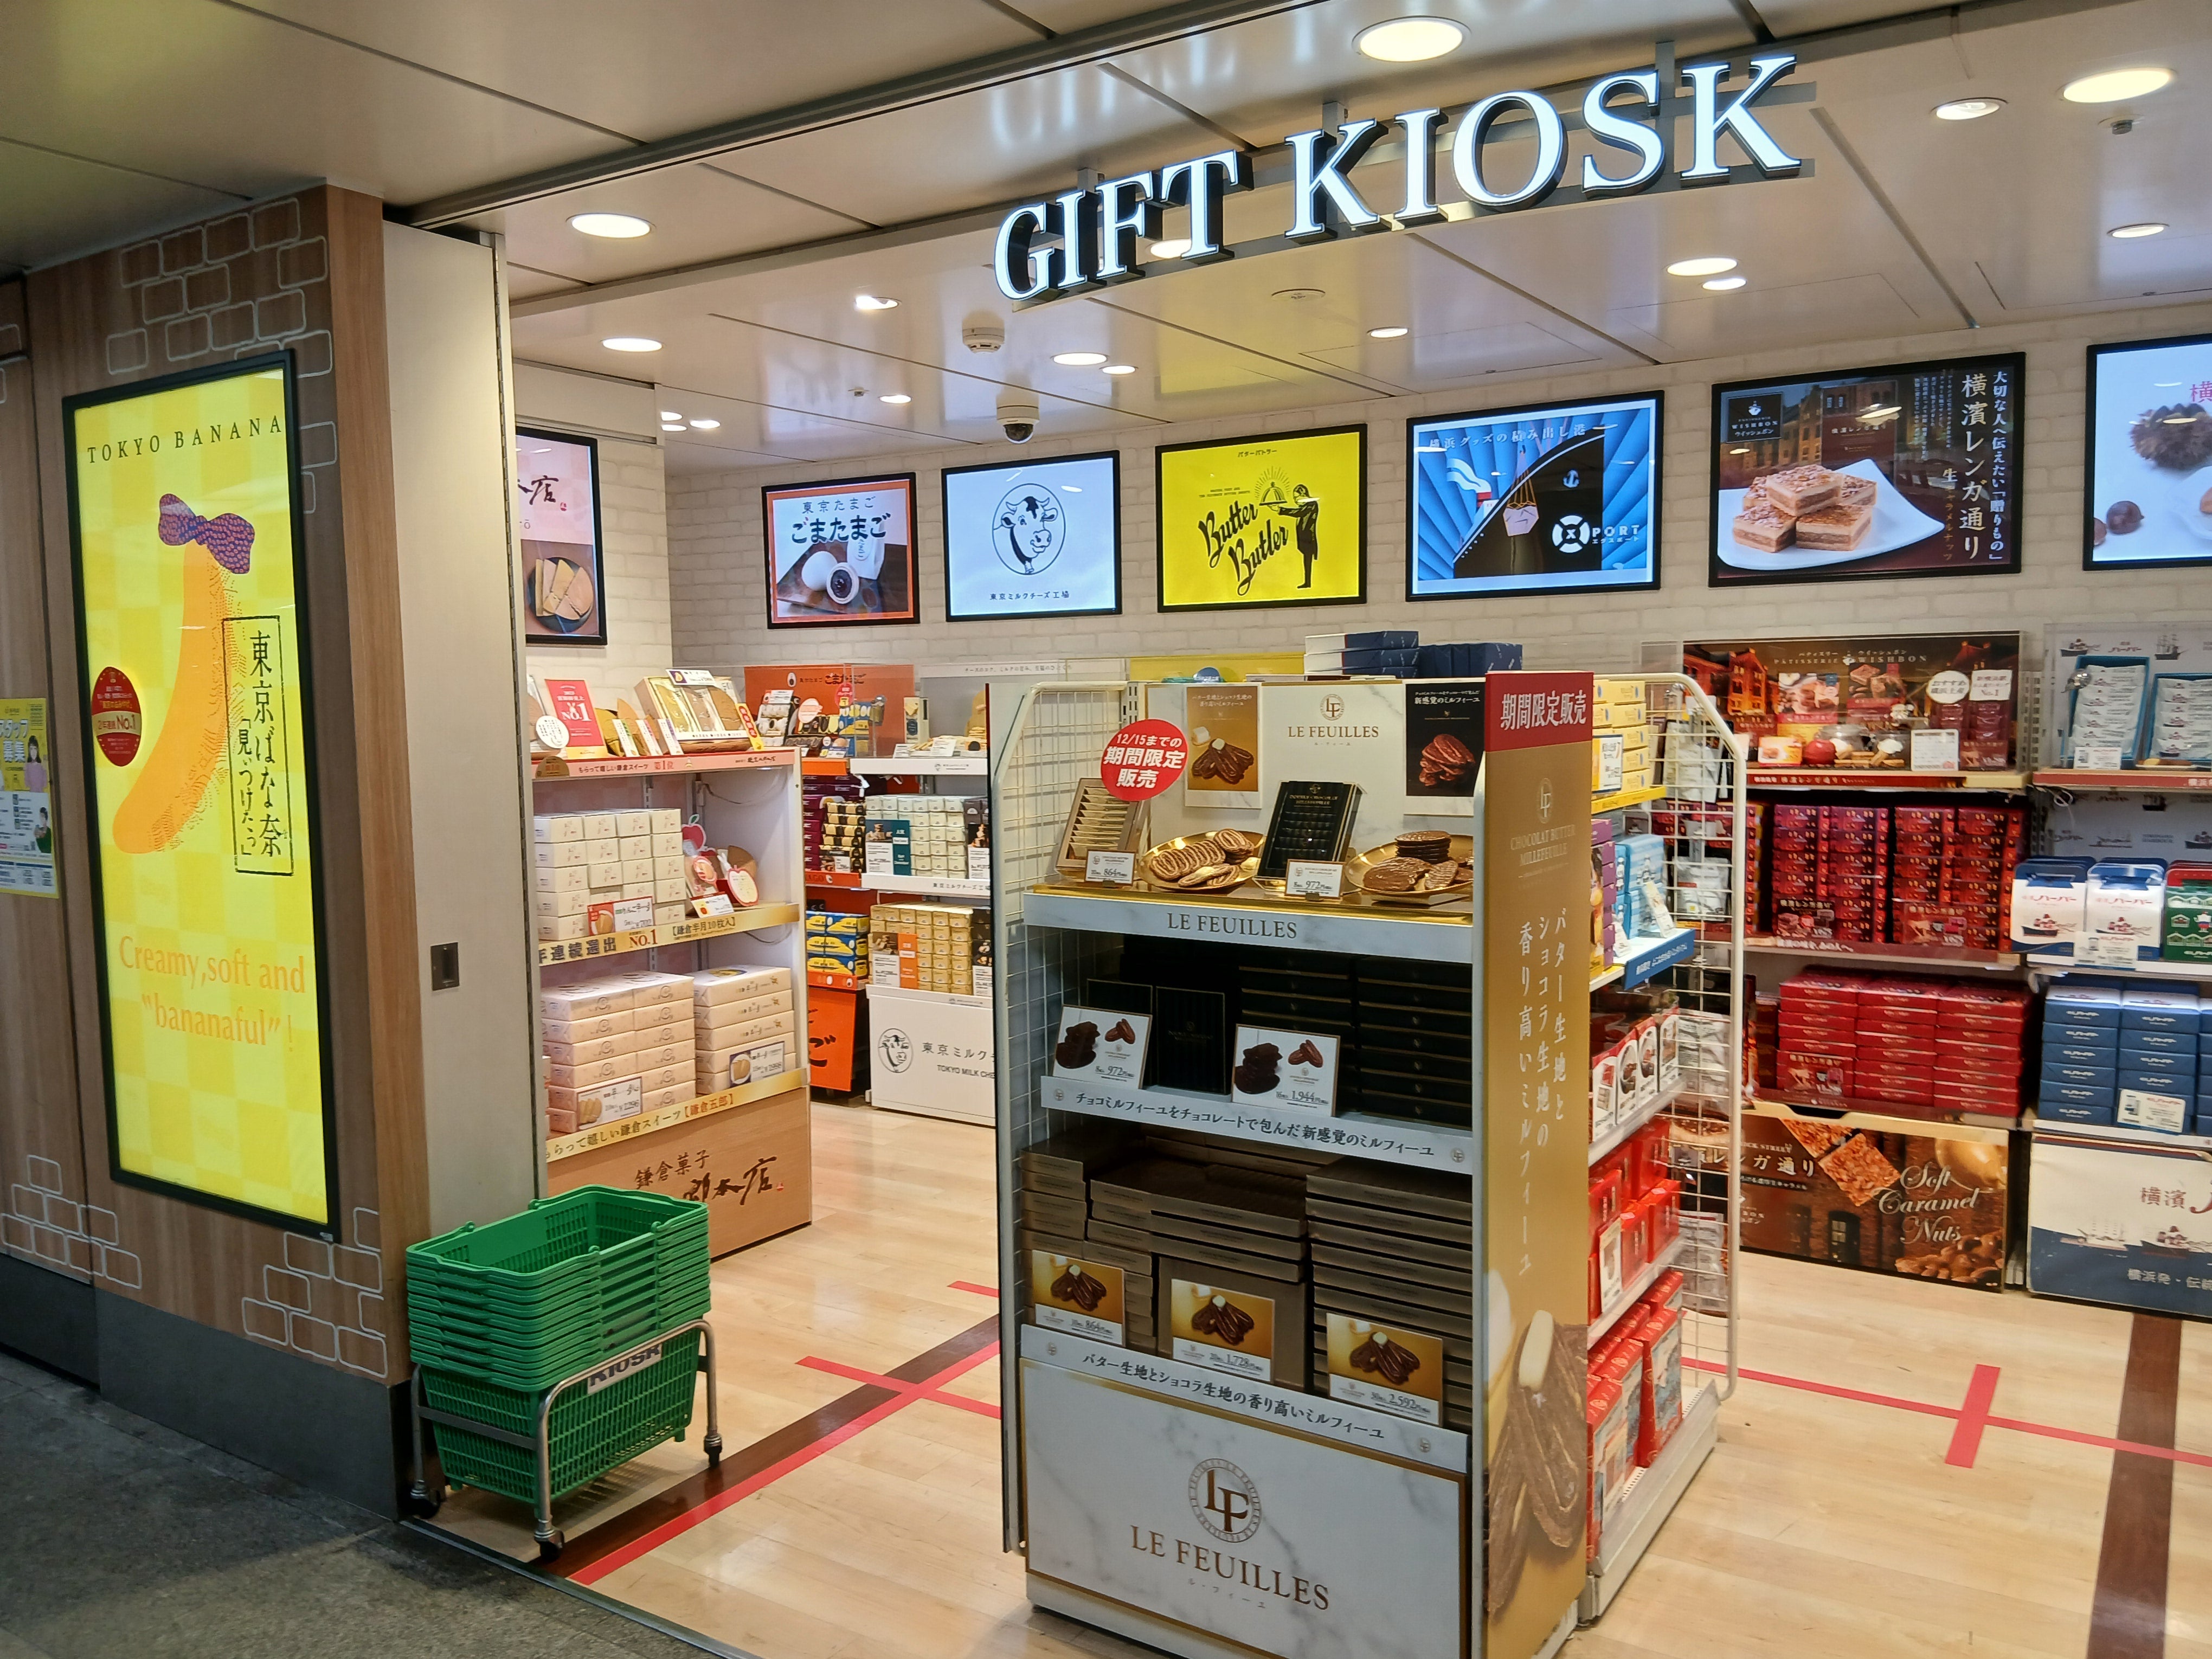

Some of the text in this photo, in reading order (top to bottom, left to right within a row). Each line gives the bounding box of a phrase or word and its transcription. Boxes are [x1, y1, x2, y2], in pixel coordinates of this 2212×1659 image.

[994, 53, 1803, 303] GIFT KIOSK
[88, 415, 282, 464] TOKYO BANANA
[1958, 373, 1988, 560] 横濱レンガ通り
[802, 496, 876, 515] 東京たまご
[791, 512, 891, 544] ごまたまご
[1198, 500, 1258, 568] Butter
[1227, 522, 1289, 596] Butler
[989, 590, 1070, 600] 東京ミルクチーズ工場
[1500, 690, 1587, 731] 期間限定販売
[250, 631, 281, 858] 東京ばな奈
[1116, 733, 1183, 748] 12/15までの
[1288, 726, 1379, 738] LE FEUILLES
[1104, 746, 1186, 769] 期間限定
[1116, 768, 1160, 789] 販売
[629, 929, 659, 948] NO.1
[1167, 912, 1298, 939] LE FEUILLES
[259, 956, 306, 994] and
[1535, 916, 1551, 1147] ショコラ生地の
[1553, 908, 1567, 1121] バター生地と
[937, 1064, 960, 1075] TOKYO
[961, 1068, 979, 1078] MILK
[1519, 922, 1534, 1276] 香り高いミルフィーユ
[1076, 1091, 1435, 1158] チョコミルフィーユをチョコレートで包んだ新感覚のミルフィーユ
[634, 1149, 710, 1189] 鎌倉菓子
[1900, 1161, 1953, 1195] Soft
[1871, 1186, 1980, 1216] Caramel
[1900, 1215, 1962, 1244] Nuts
[1082, 1353, 1385, 1439] バター生地とショコラ生地の香り高いミルフィーユ
[1130, 1525, 1330, 1611] LE FEUILLES
